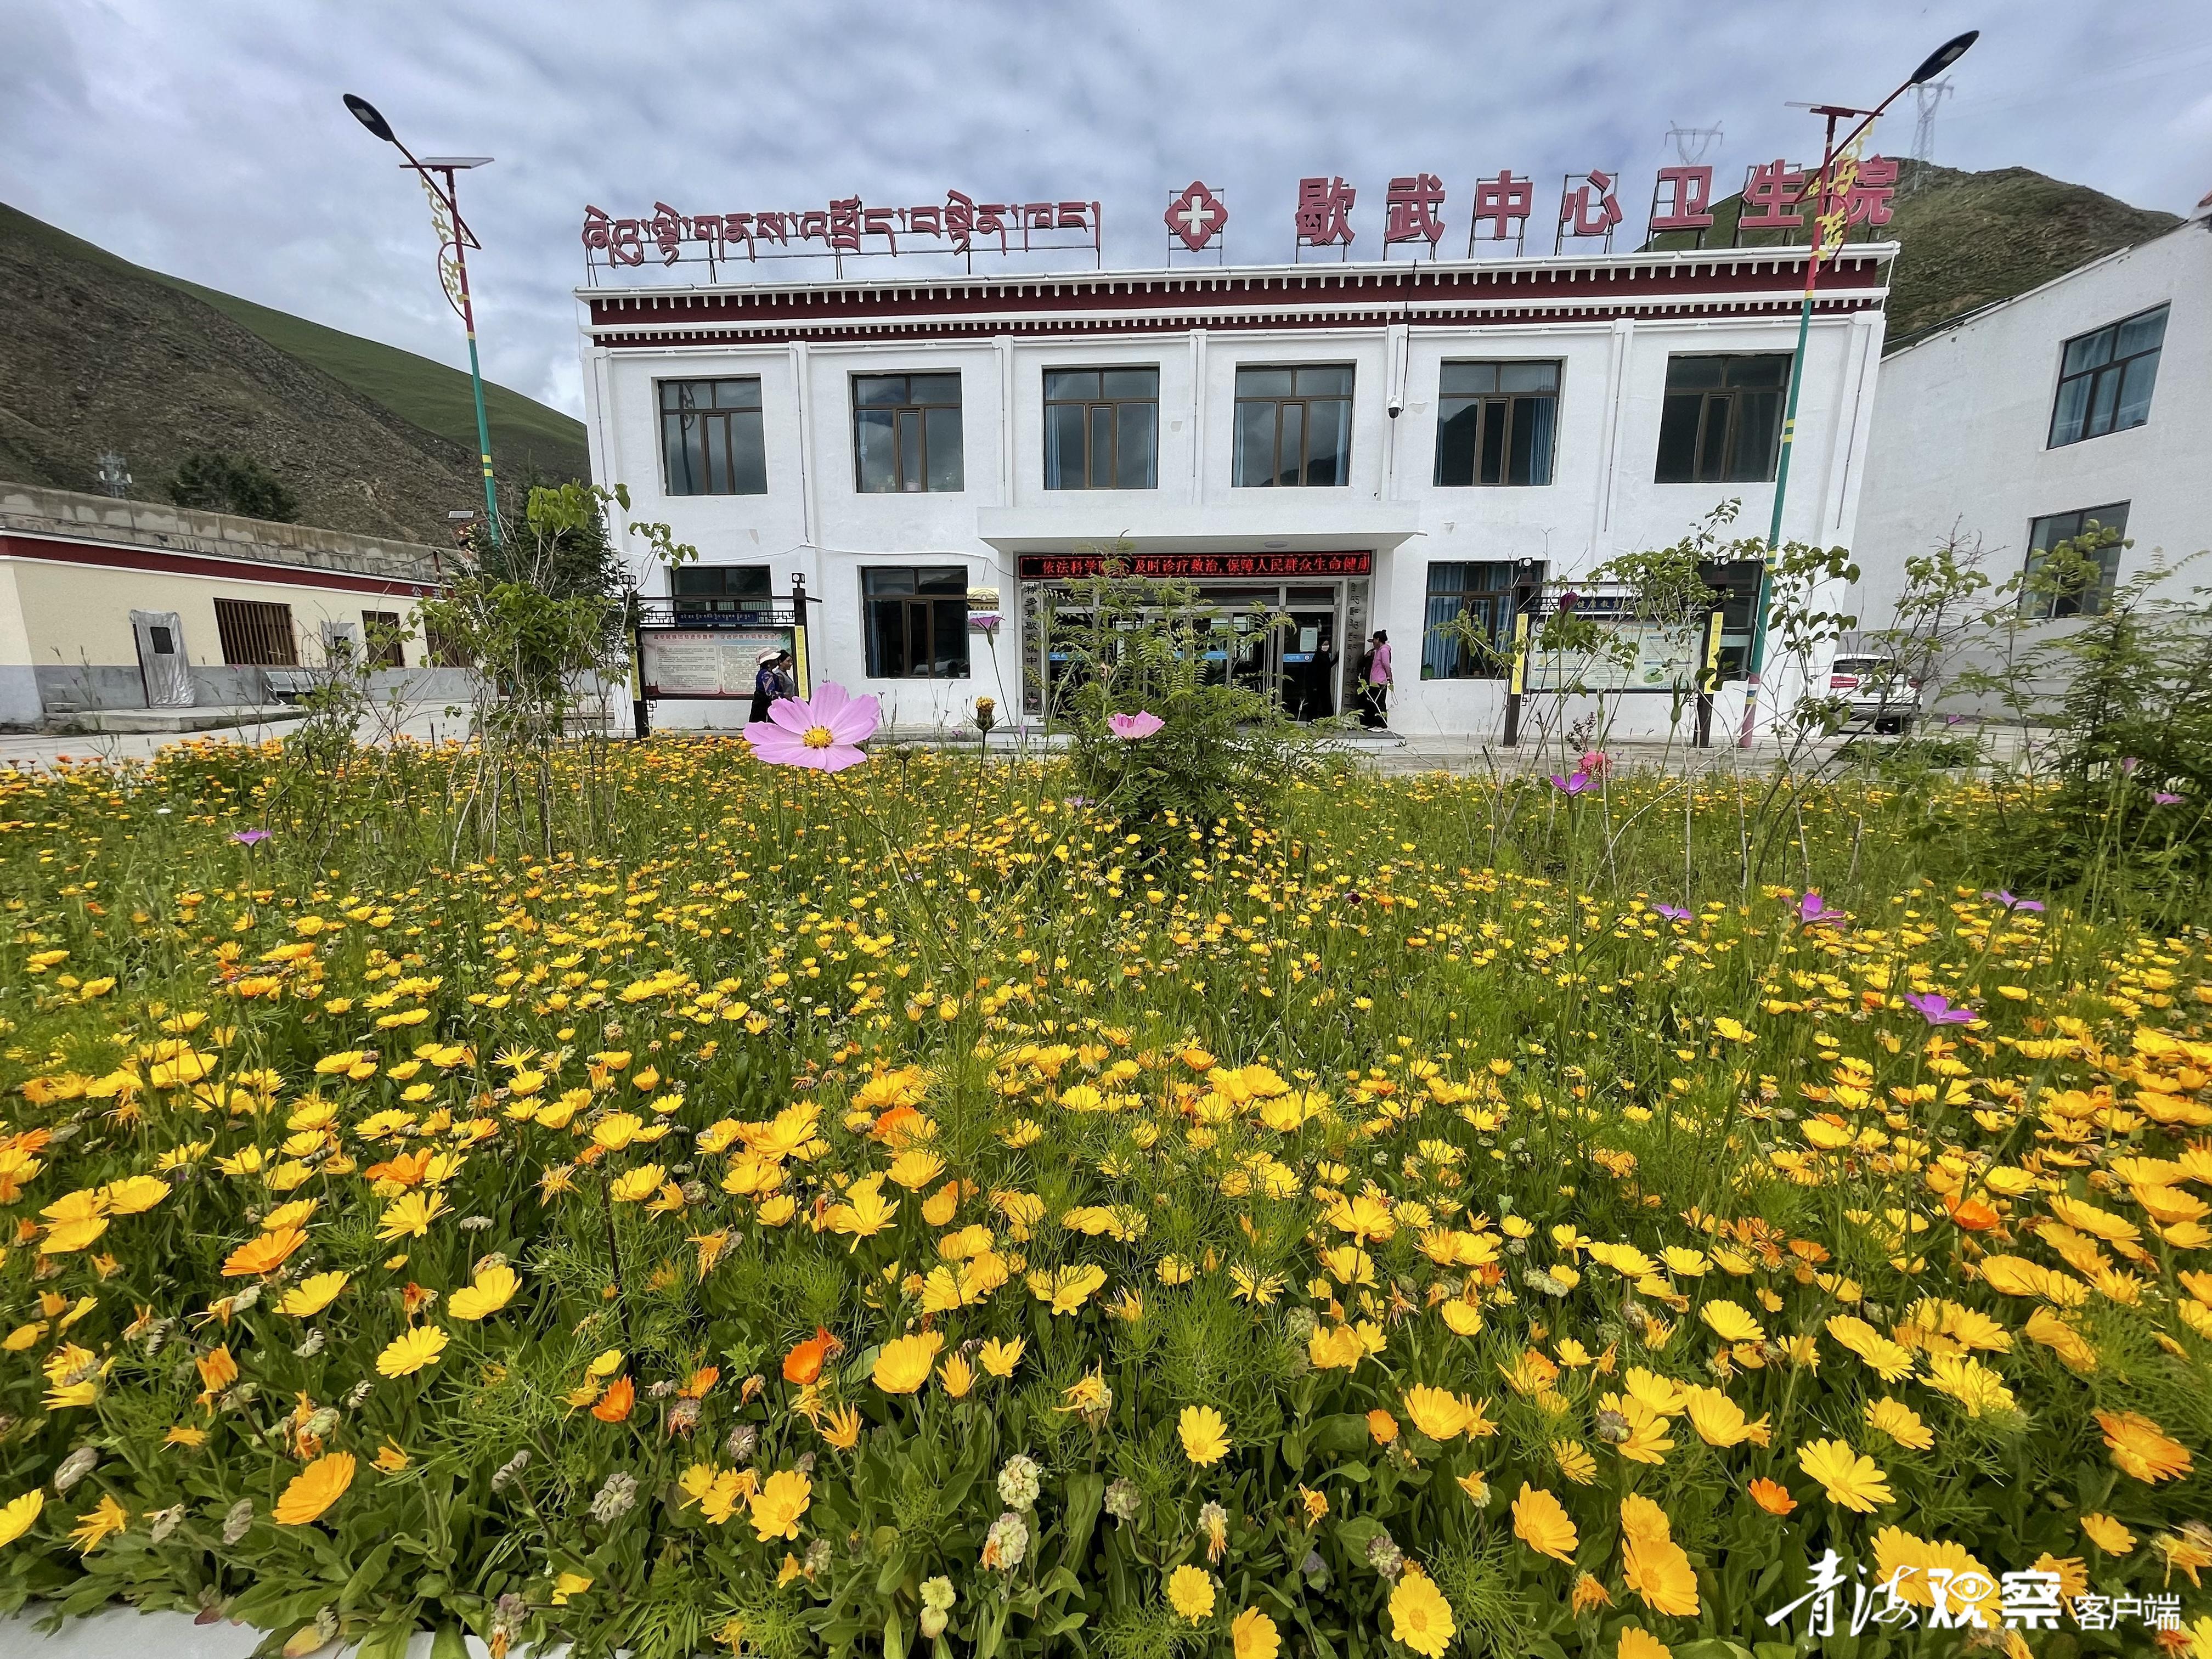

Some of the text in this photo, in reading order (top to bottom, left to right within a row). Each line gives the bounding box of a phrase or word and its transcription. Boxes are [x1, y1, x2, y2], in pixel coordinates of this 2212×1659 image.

[1295, 153, 1898, 247] 歇武中心卫生院
[1024, 585, 1039, 712] 称多县歇武镇中卫生院
